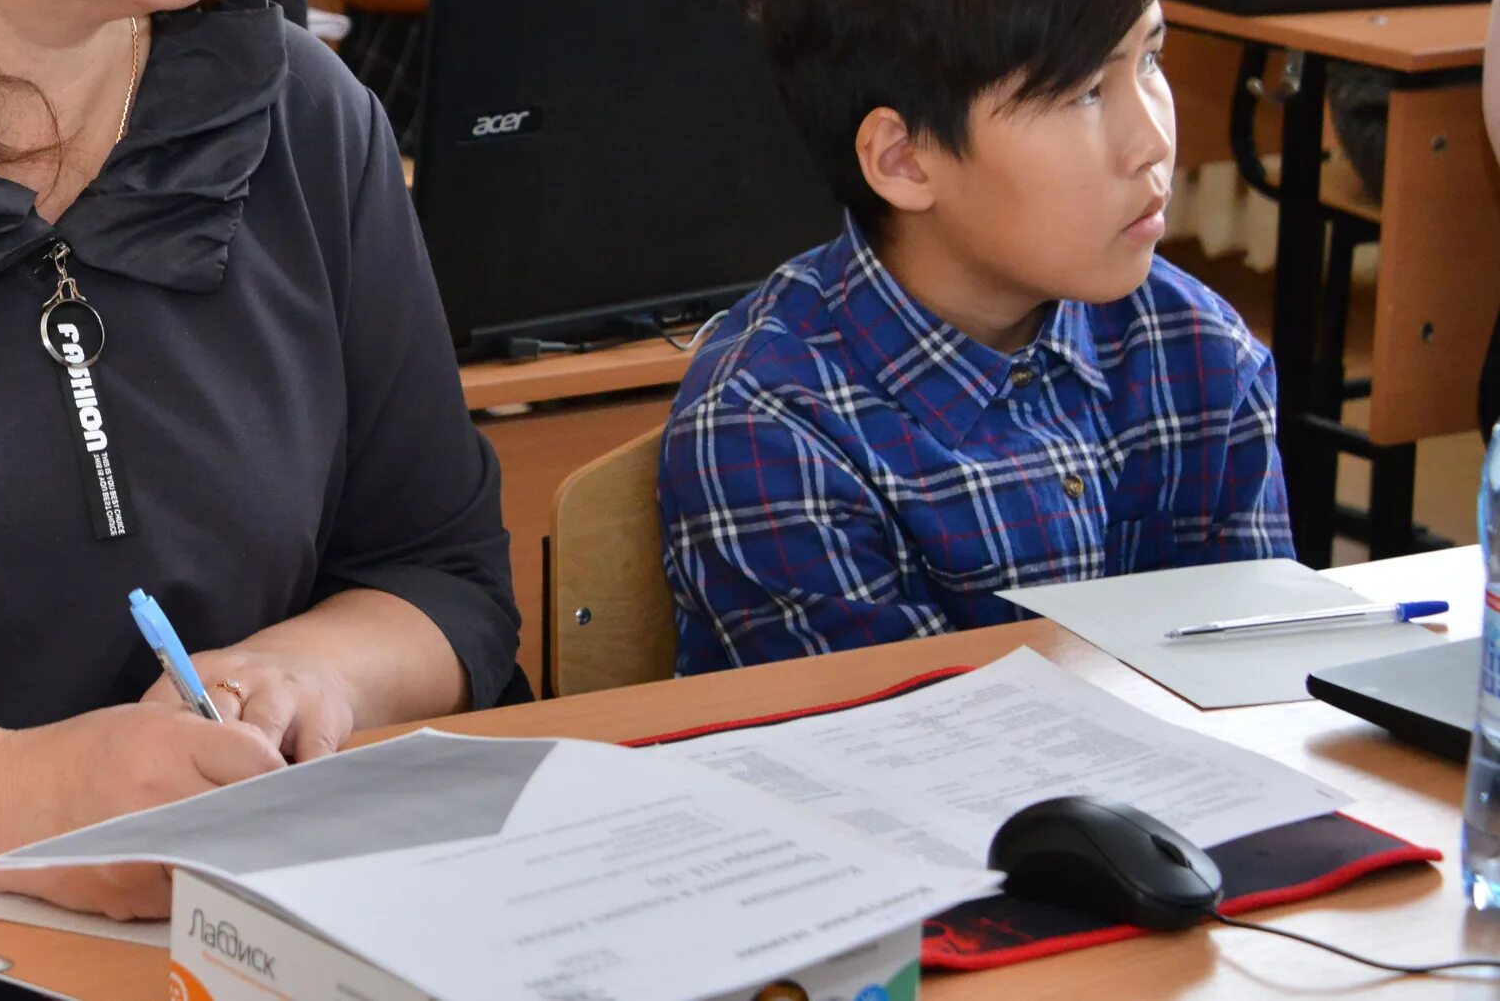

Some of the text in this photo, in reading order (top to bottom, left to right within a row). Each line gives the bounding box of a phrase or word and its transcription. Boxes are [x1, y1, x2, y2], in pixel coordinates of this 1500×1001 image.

[472, 110, 530, 136] acer
[57, 322, 108, 453] FASHION
[188, 907, 277, 980] Лабдиск
